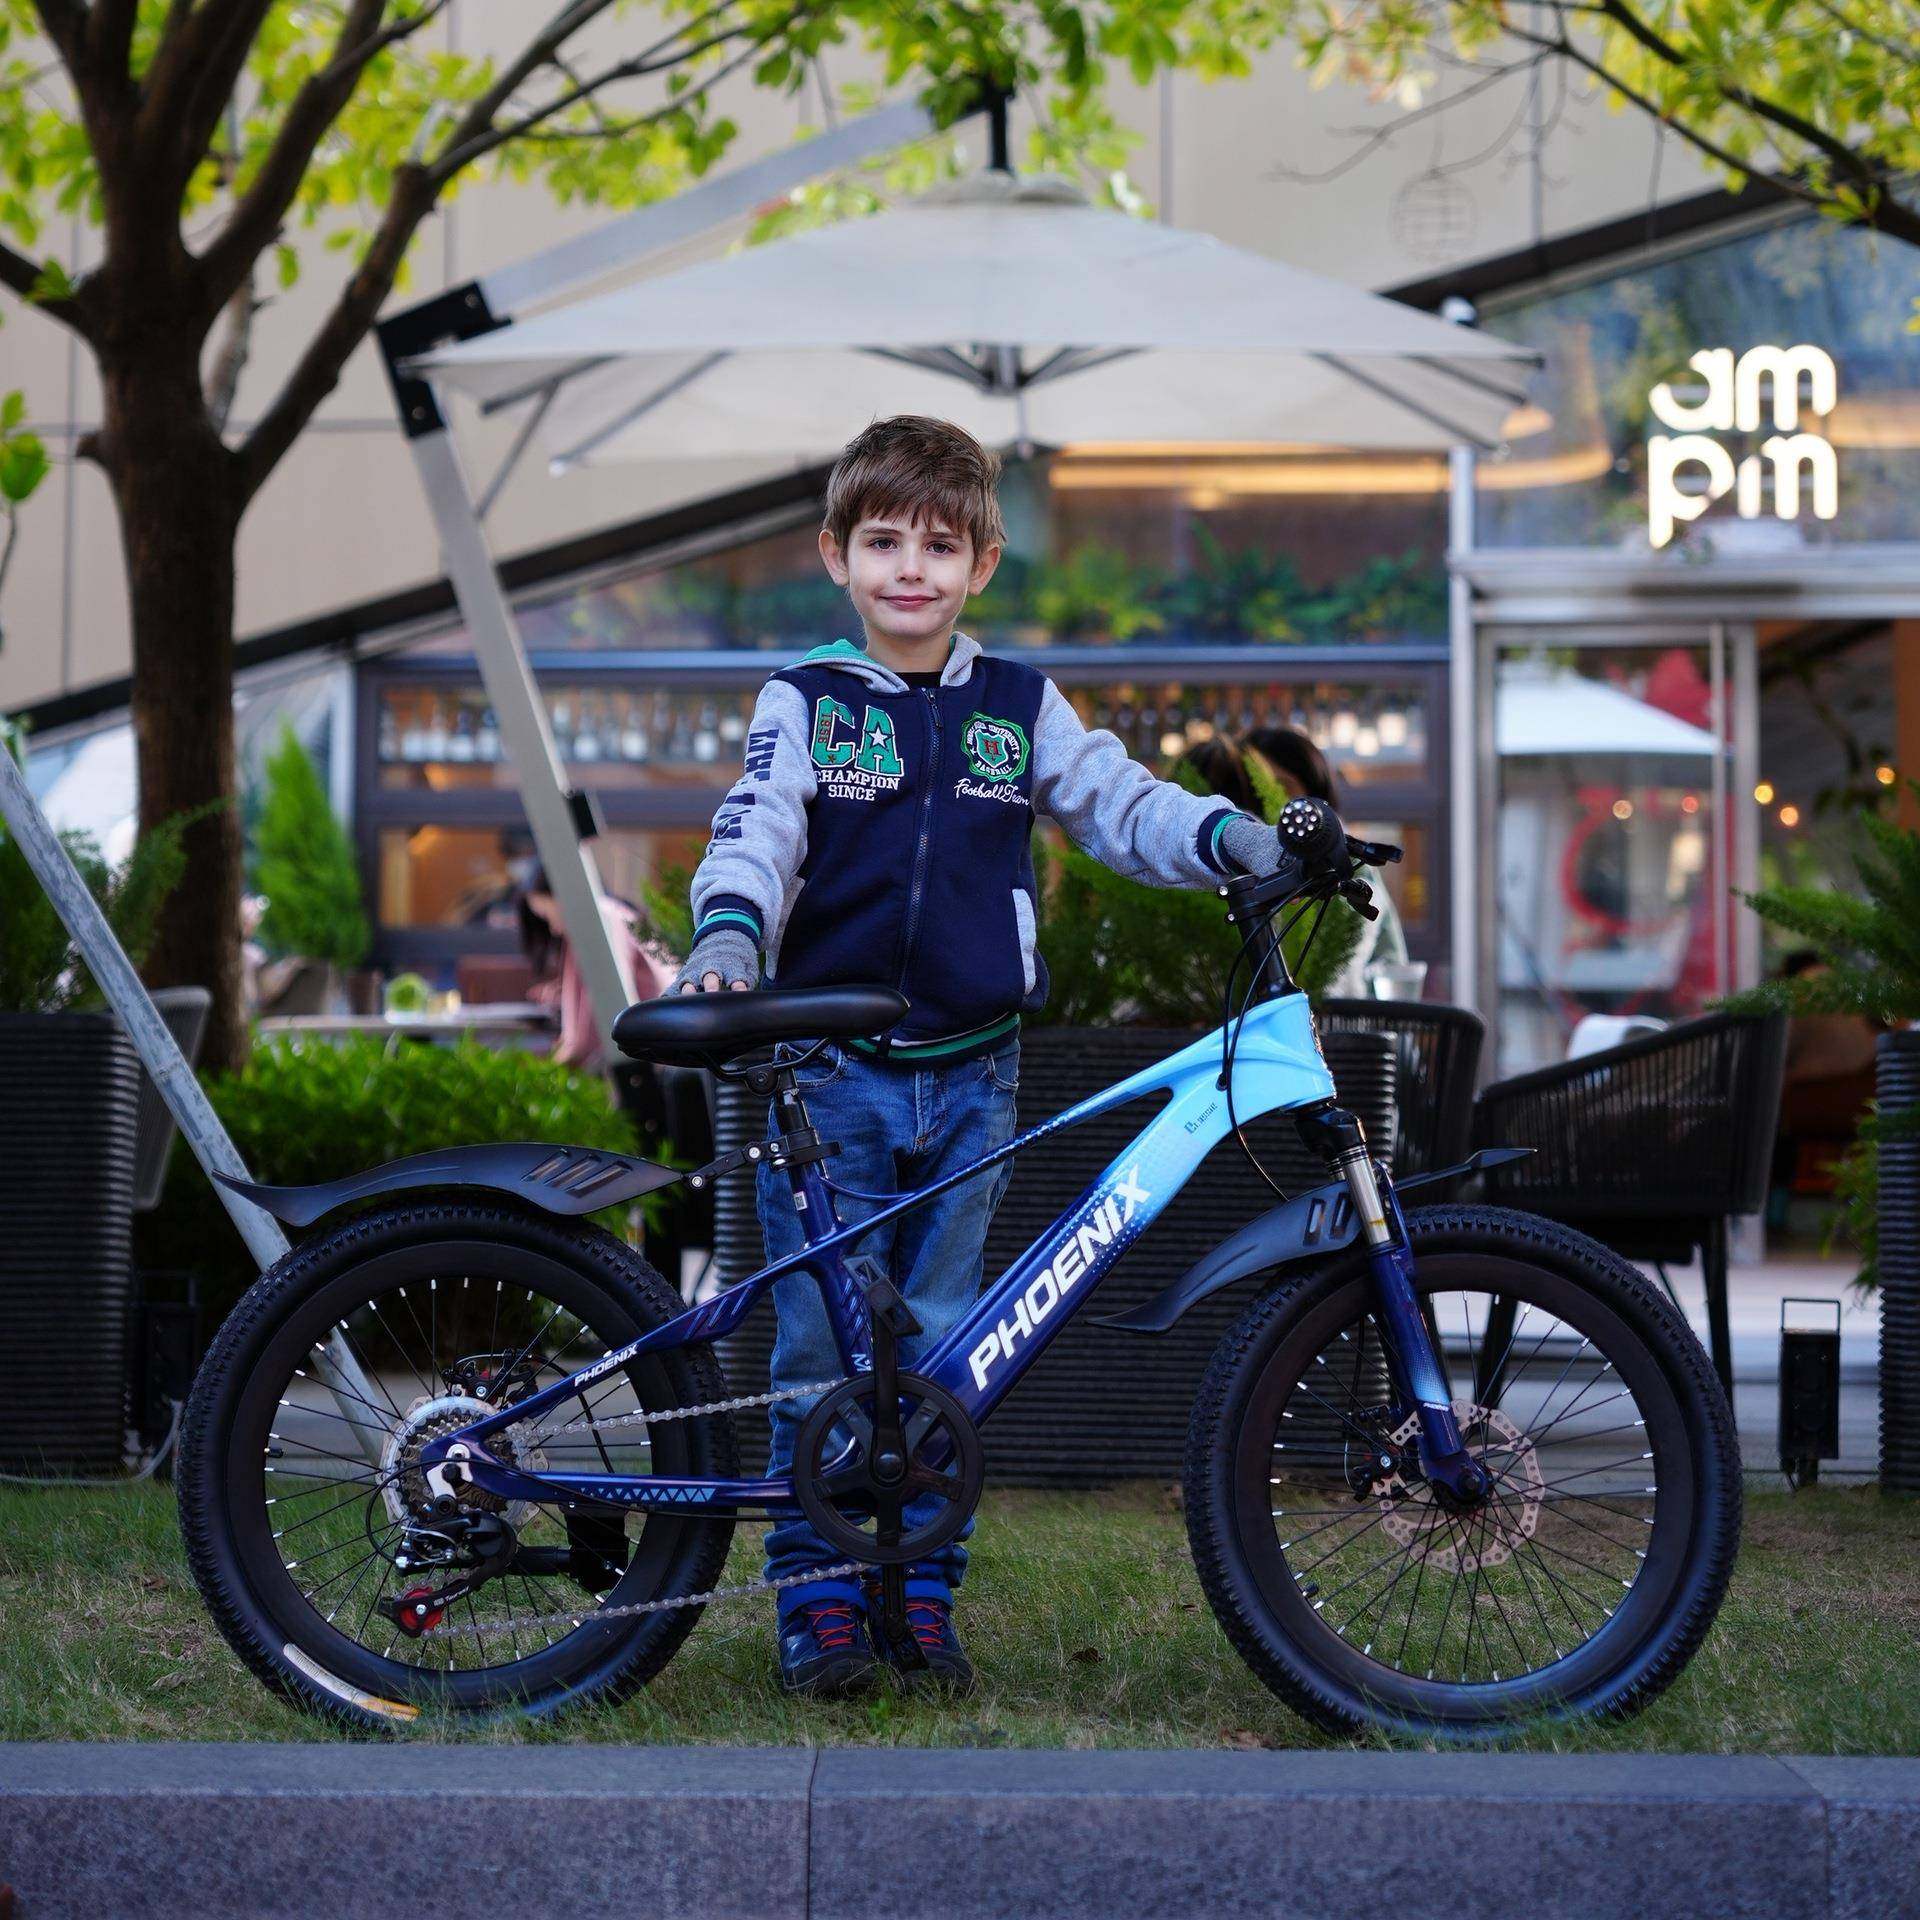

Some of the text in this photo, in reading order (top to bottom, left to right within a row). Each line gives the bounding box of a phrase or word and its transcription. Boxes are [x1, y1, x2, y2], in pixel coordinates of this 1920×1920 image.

[1648, 344, 1837, 432] am
[1647, 433, 1838, 549] pm
[811, 695, 904, 777] CA
[828, 784, 876, 802] SINCE
[954, 778, 1004, 800] Football
[968, 1163, 1151, 1392] PHOENIX
[575, 1344, 638, 1387] PHOENIX
